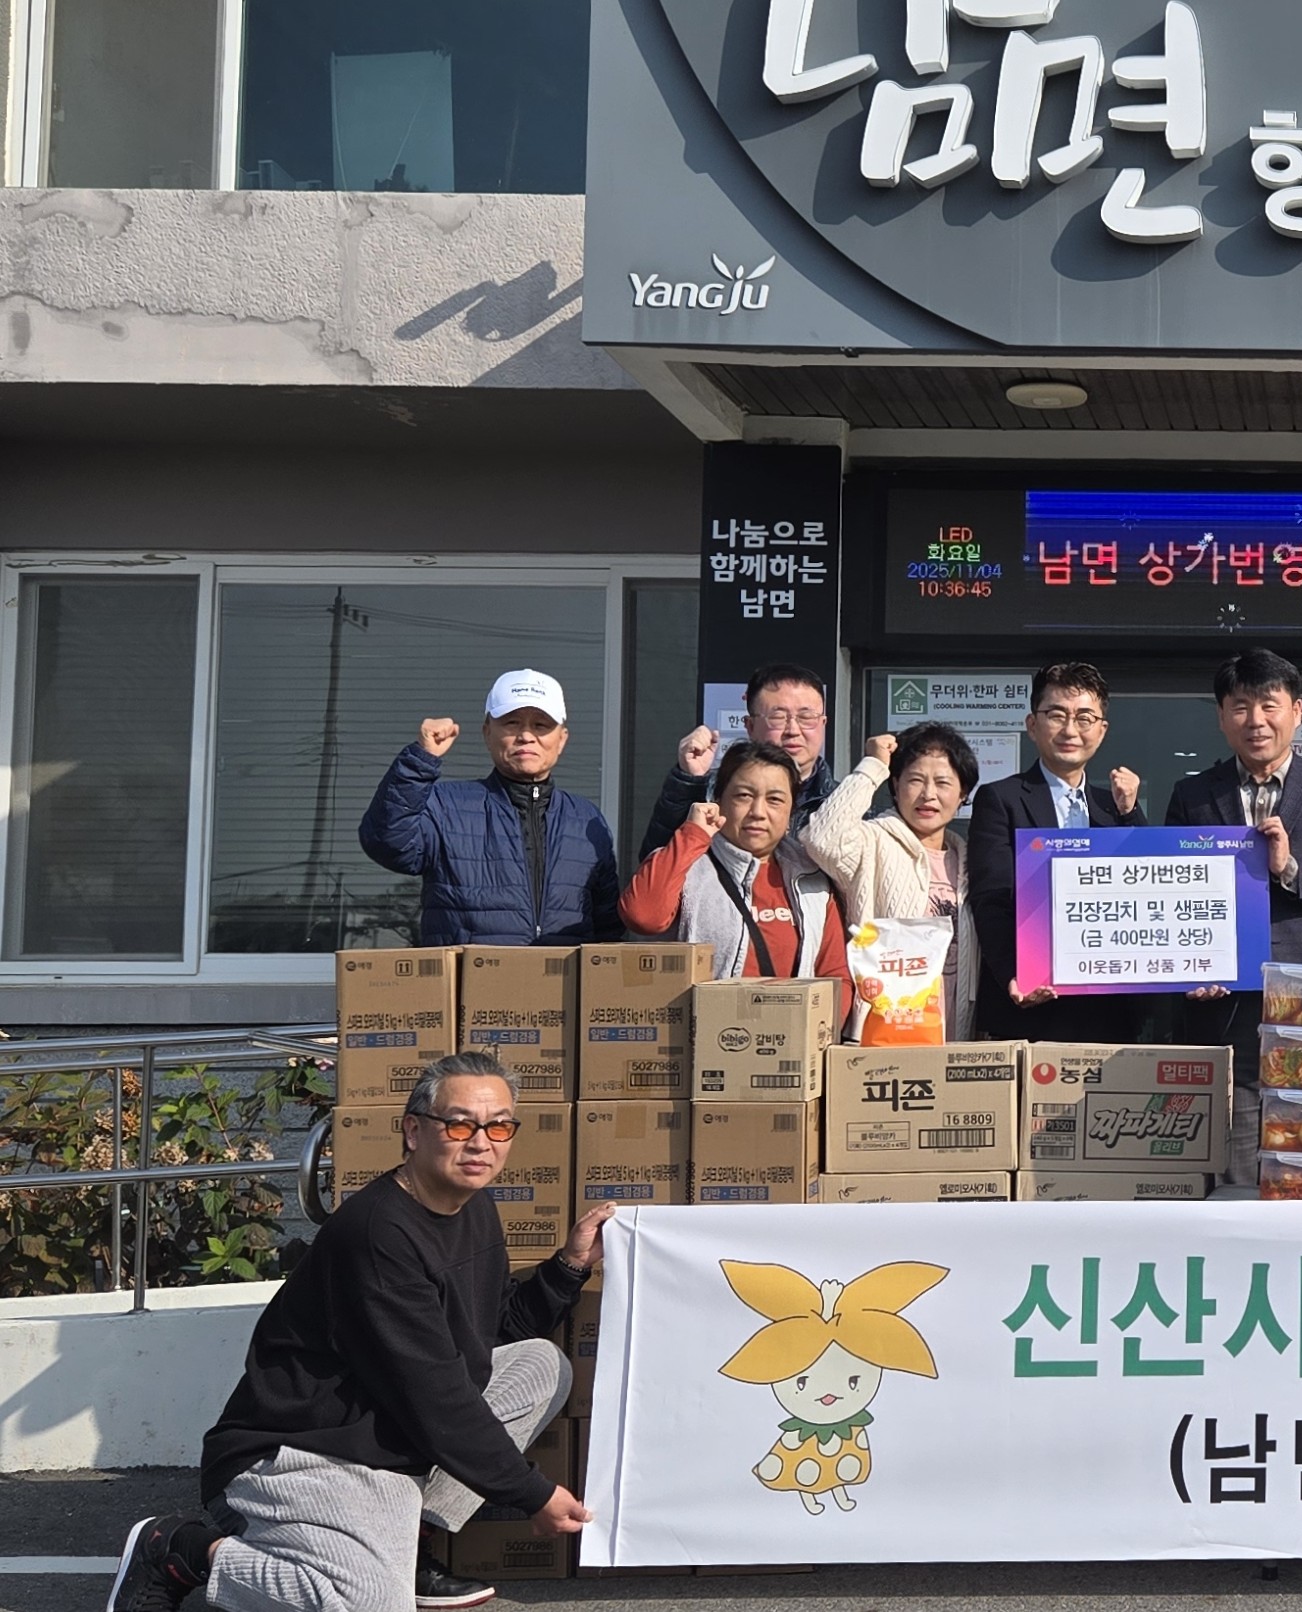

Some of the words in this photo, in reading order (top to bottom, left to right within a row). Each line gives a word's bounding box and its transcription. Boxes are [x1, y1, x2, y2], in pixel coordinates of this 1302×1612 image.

[712, 519, 828, 548] 나눔으로
[939, 527, 973, 542] LED
[927, 543, 981, 562] 화요일
[709, 552, 827, 584] 함께하는
[907, 562, 1003, 578] 2025/11/04
[1039, 540, 1118, 585] 남면
[918, 580, 992, 598] 10:36:45
[740, 589, 795, 618] 남면
[930, 684, 998, 698] 무더위·한파
[1003, 684, 1028, 698] 쉼터
[1078, 865, 1113, 885] 남면
[1122, 863, 1209, 885] 상가번영회
[1065, 901, 1138, 922] 김장김치
[1147, 900, 1165, 921] 및
[1174, 899, 1229, 921] 생필품
[1080, 929, 1104, 948] (금
[1110, 929, 1170, 947] 400만원
[1177, 927, 1213, 946] 상당)
[877, 956, 928, 977] 피죤
[1078, 960, 1138, 974] 이웃돕기
[1146, 959, 1175, 973] 성품
[1183, 958, 1213, 973] 기부
[347, 1035, 367, 1047] 일반
[472, 1031, 491, 1043] 일반
[591, 1028, 609, 1040] 일반
[721, 1033, 750, 1045] bibigo
[755, 1033, 786, 1046] 갈비탕
[513, 1064, 562, 1074] 5027986
[631, 1061, 680, 1072] 5027986
[1161, 1063, 1209, 1082] 멀티팩
[1059, 1066, 1103, 1084] 농심
[861, 1078, 936, 1112] 피죤
[946, 1114, 959, 1125] 16
[962, 1113, 992, 1125] 8809
[1088, 1107, 1204, 1149] 짜파게티
[1152, 1141, 1182, 1153] 올리브
[586, 1187, 605, 1198] 일반
[702, 1188, 720, 1199] 일반
[507, 1221, 556, 1231] 5027986
